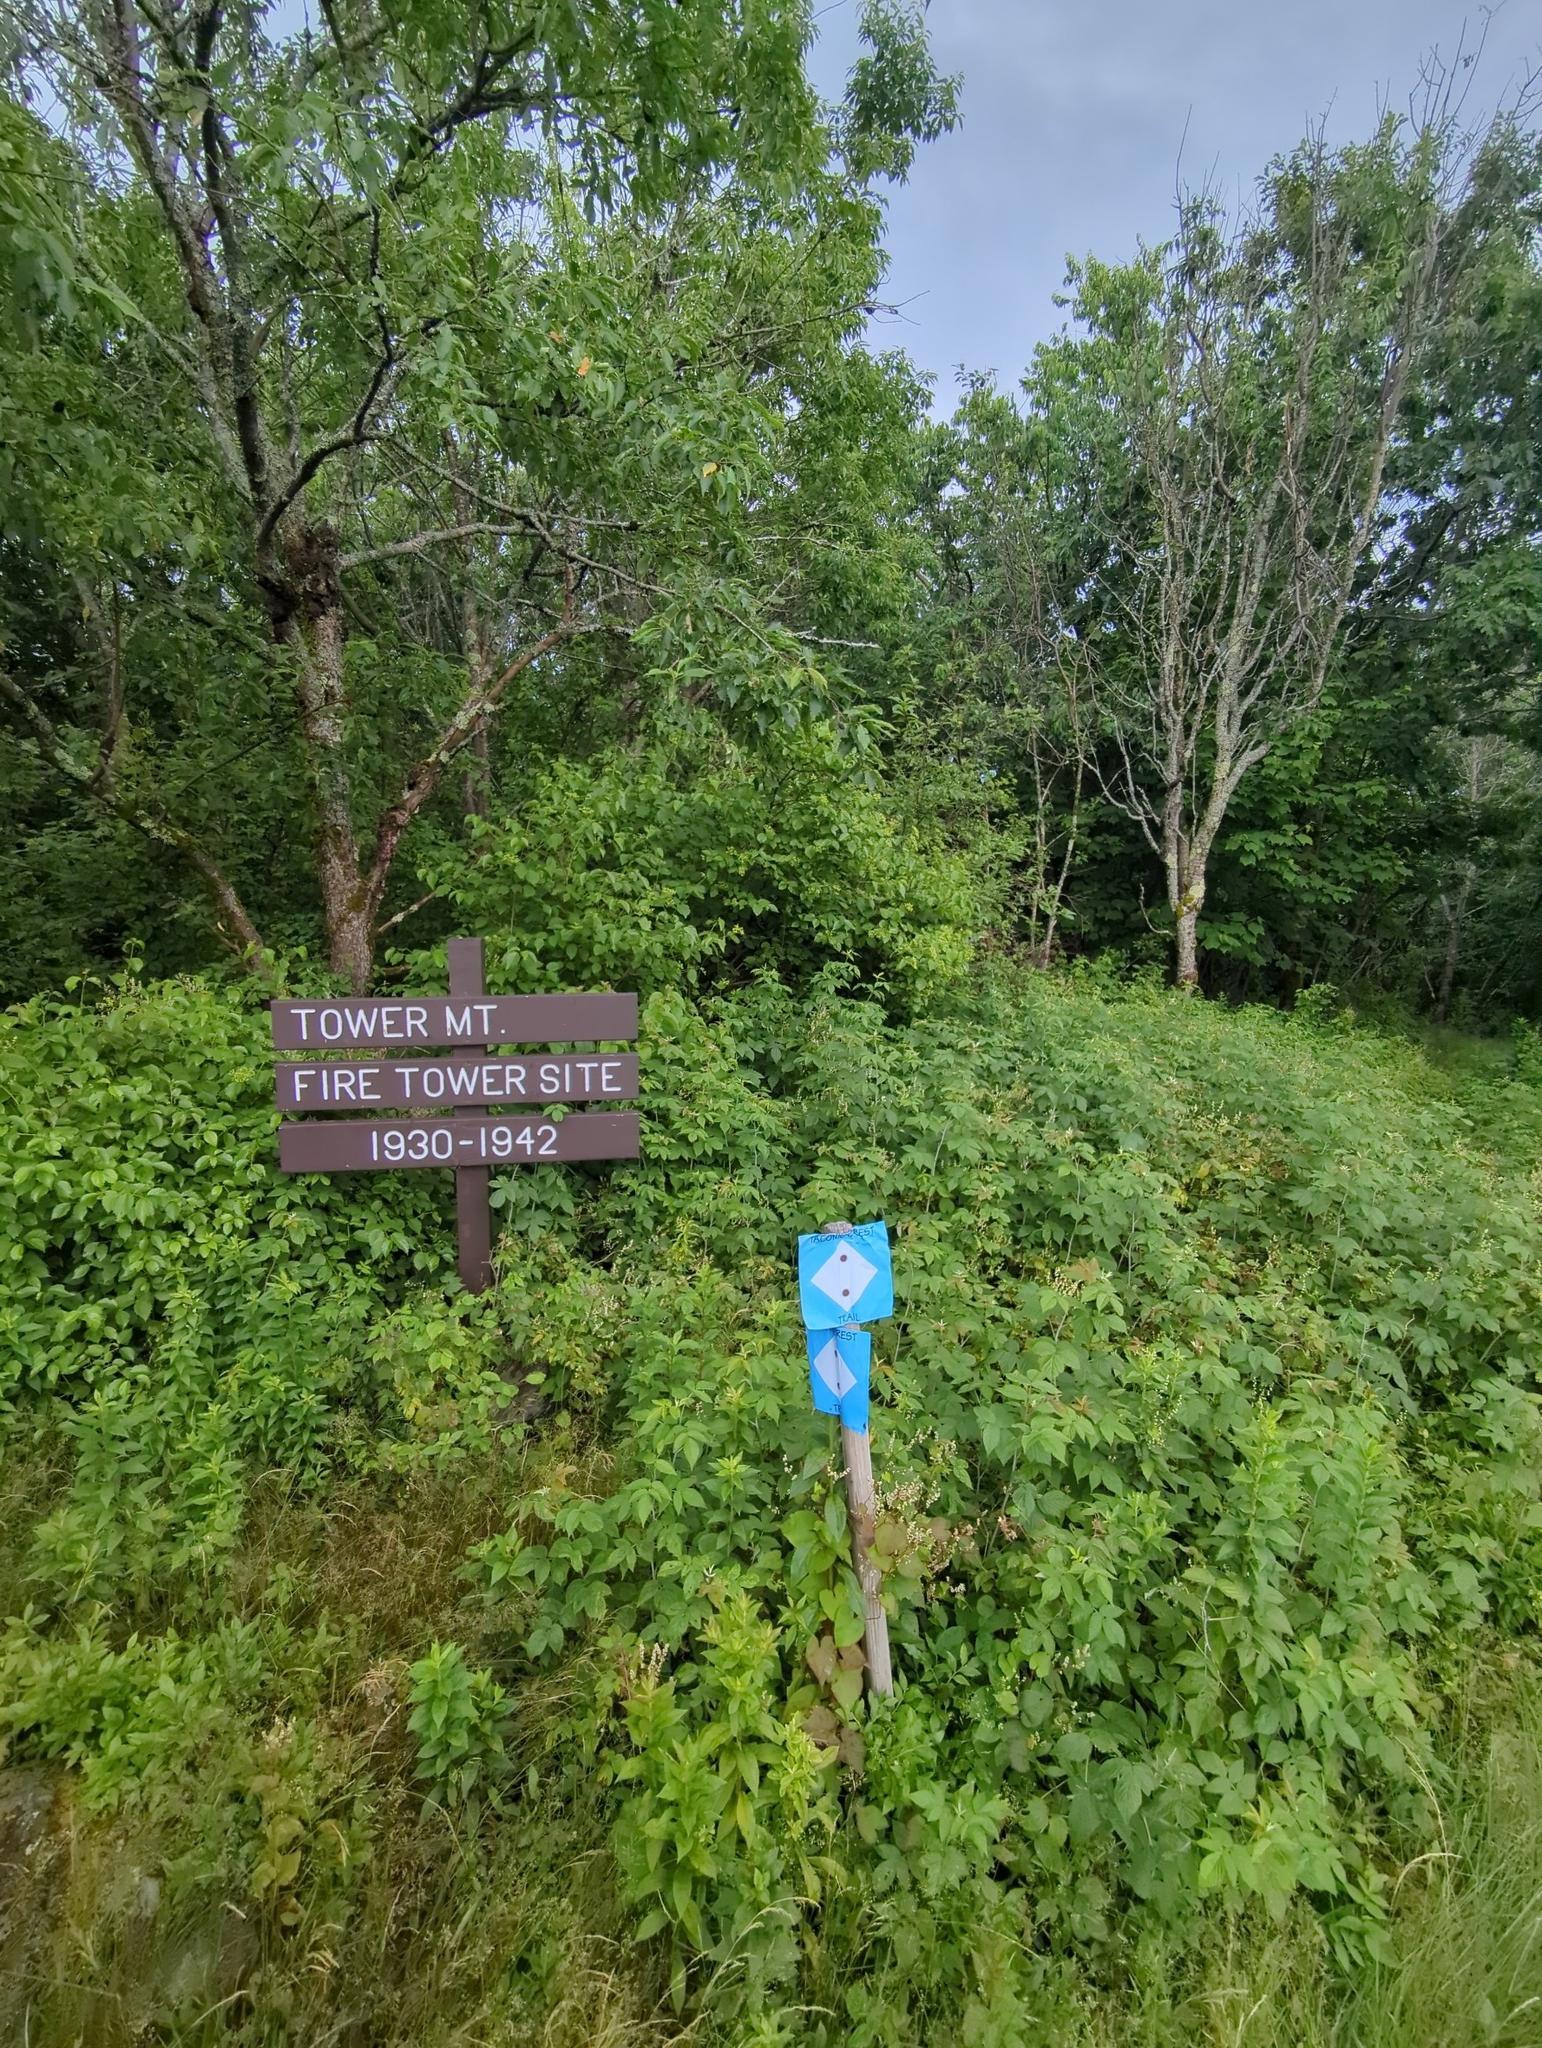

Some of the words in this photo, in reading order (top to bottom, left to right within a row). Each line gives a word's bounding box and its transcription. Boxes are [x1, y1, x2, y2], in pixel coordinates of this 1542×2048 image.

[290, 1006, 429, 1041] TOWER
[445, 1004, 506, 1037] MT.
[293, 1068, 381, 1102] FIRE
[394, 1063, 527, 1099] TOWER
[539, 1061, 622, 1094] SITE
[371, 1124, 558, 1162] 1930-1942
